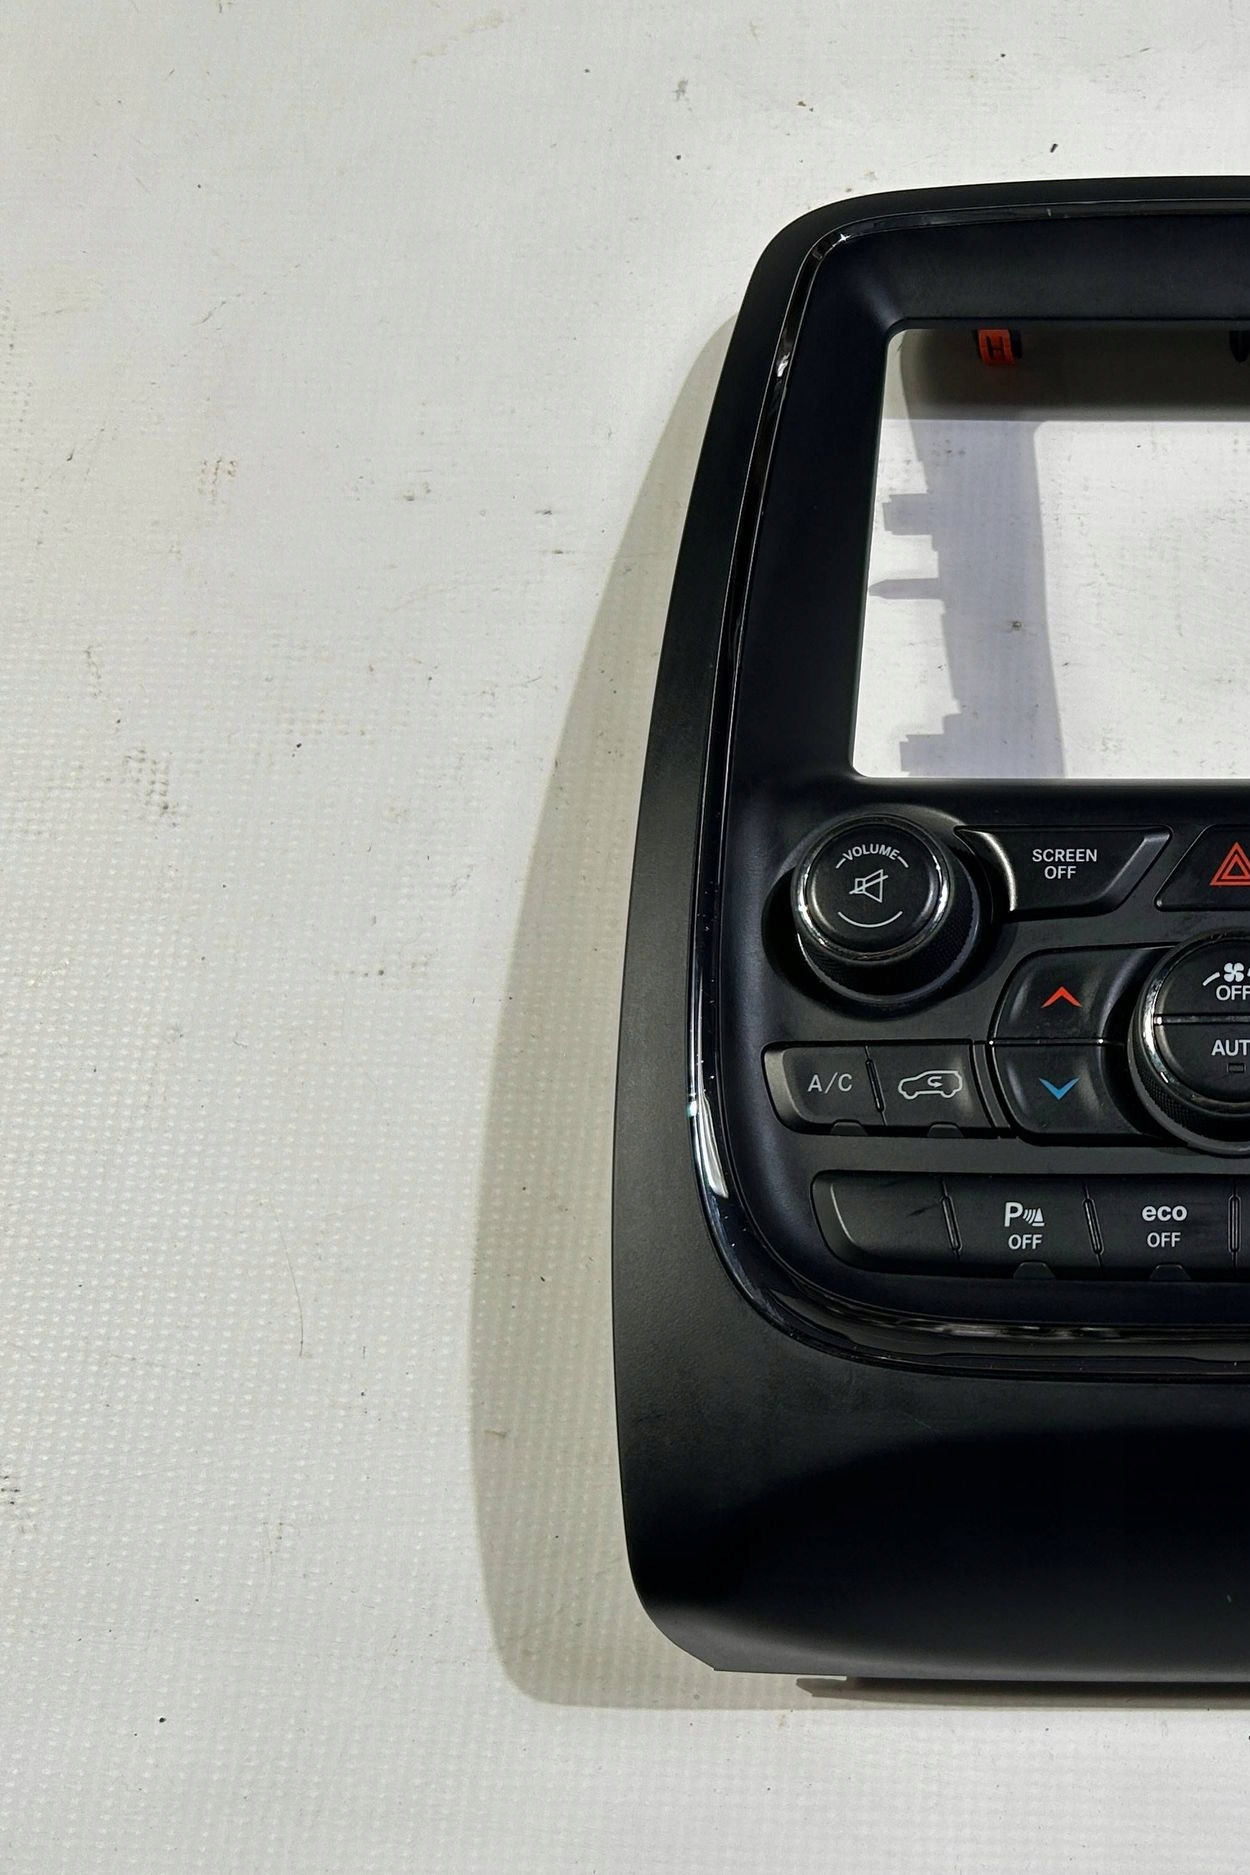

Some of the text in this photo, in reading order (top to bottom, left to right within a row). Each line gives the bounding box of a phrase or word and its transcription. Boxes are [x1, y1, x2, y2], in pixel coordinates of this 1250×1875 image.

[842, 844, 900, 862] VOLUME
[1032, 848, 1098, 863] SCREEN
[1044, 866, 1077, 880] OFF
[807, 1073, 854, 1093] A/C
[1142, 1205, 1188, 1222] eco
[1008, 1234, 1042, 1250] OFF
[1146, 1232, 1181, 1248] OFF
